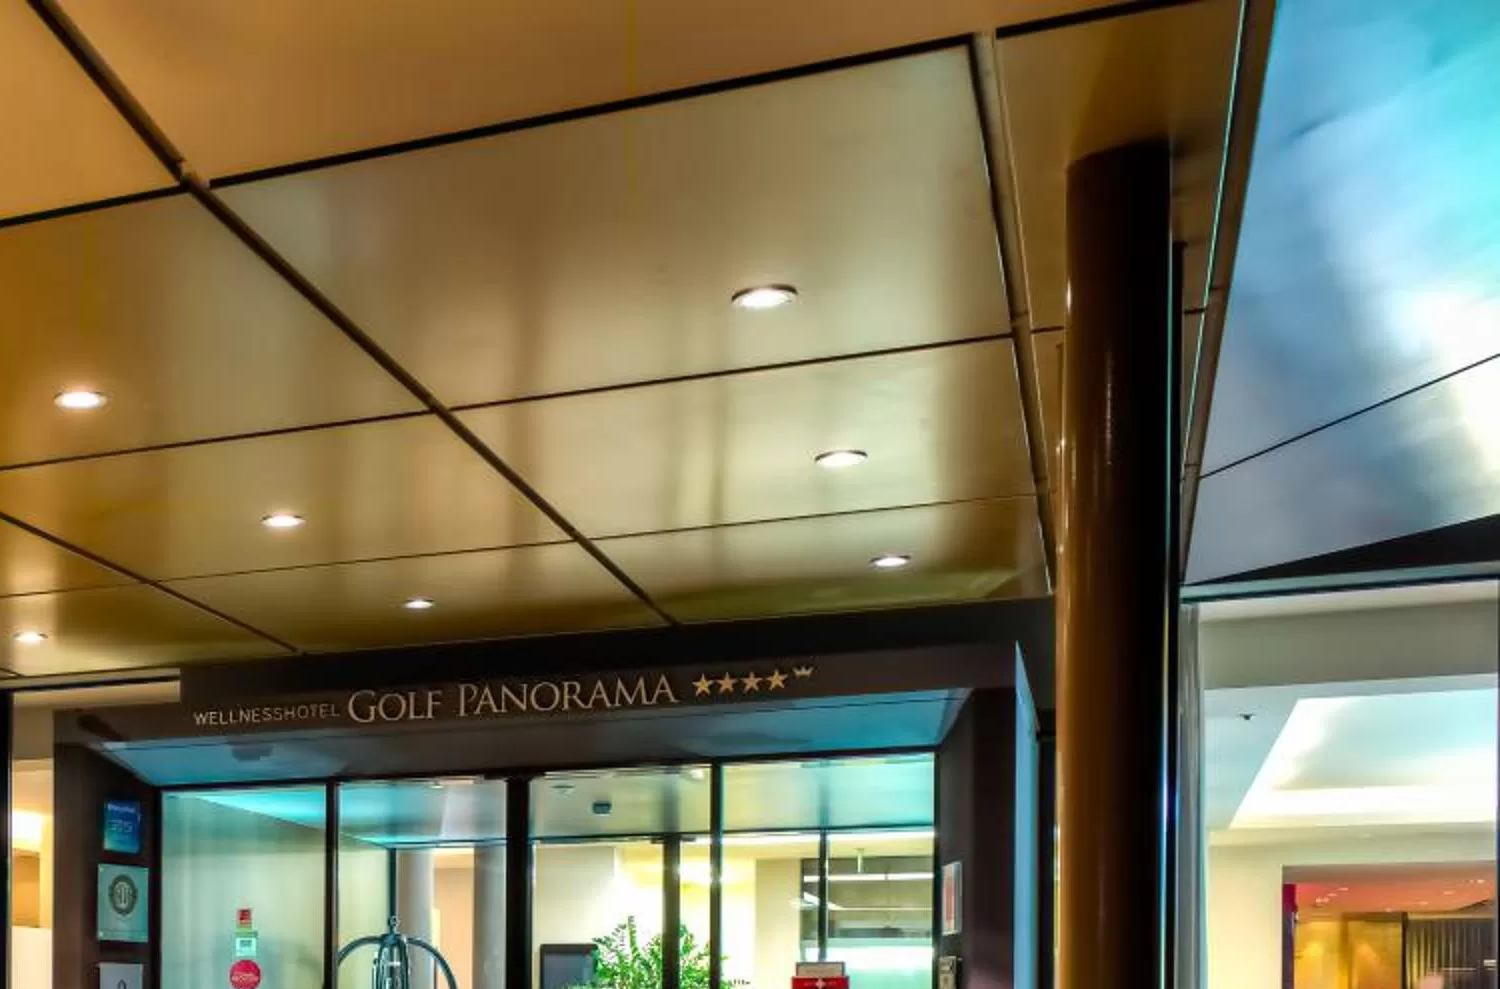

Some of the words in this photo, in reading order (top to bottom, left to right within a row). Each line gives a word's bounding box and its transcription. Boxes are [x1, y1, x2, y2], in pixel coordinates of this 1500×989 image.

[193, 704, 340, 725] WELLNESSHOTEL
[348, 689, 442, 723] GOLF
[458, 674, 678, 717] PANORAMA
